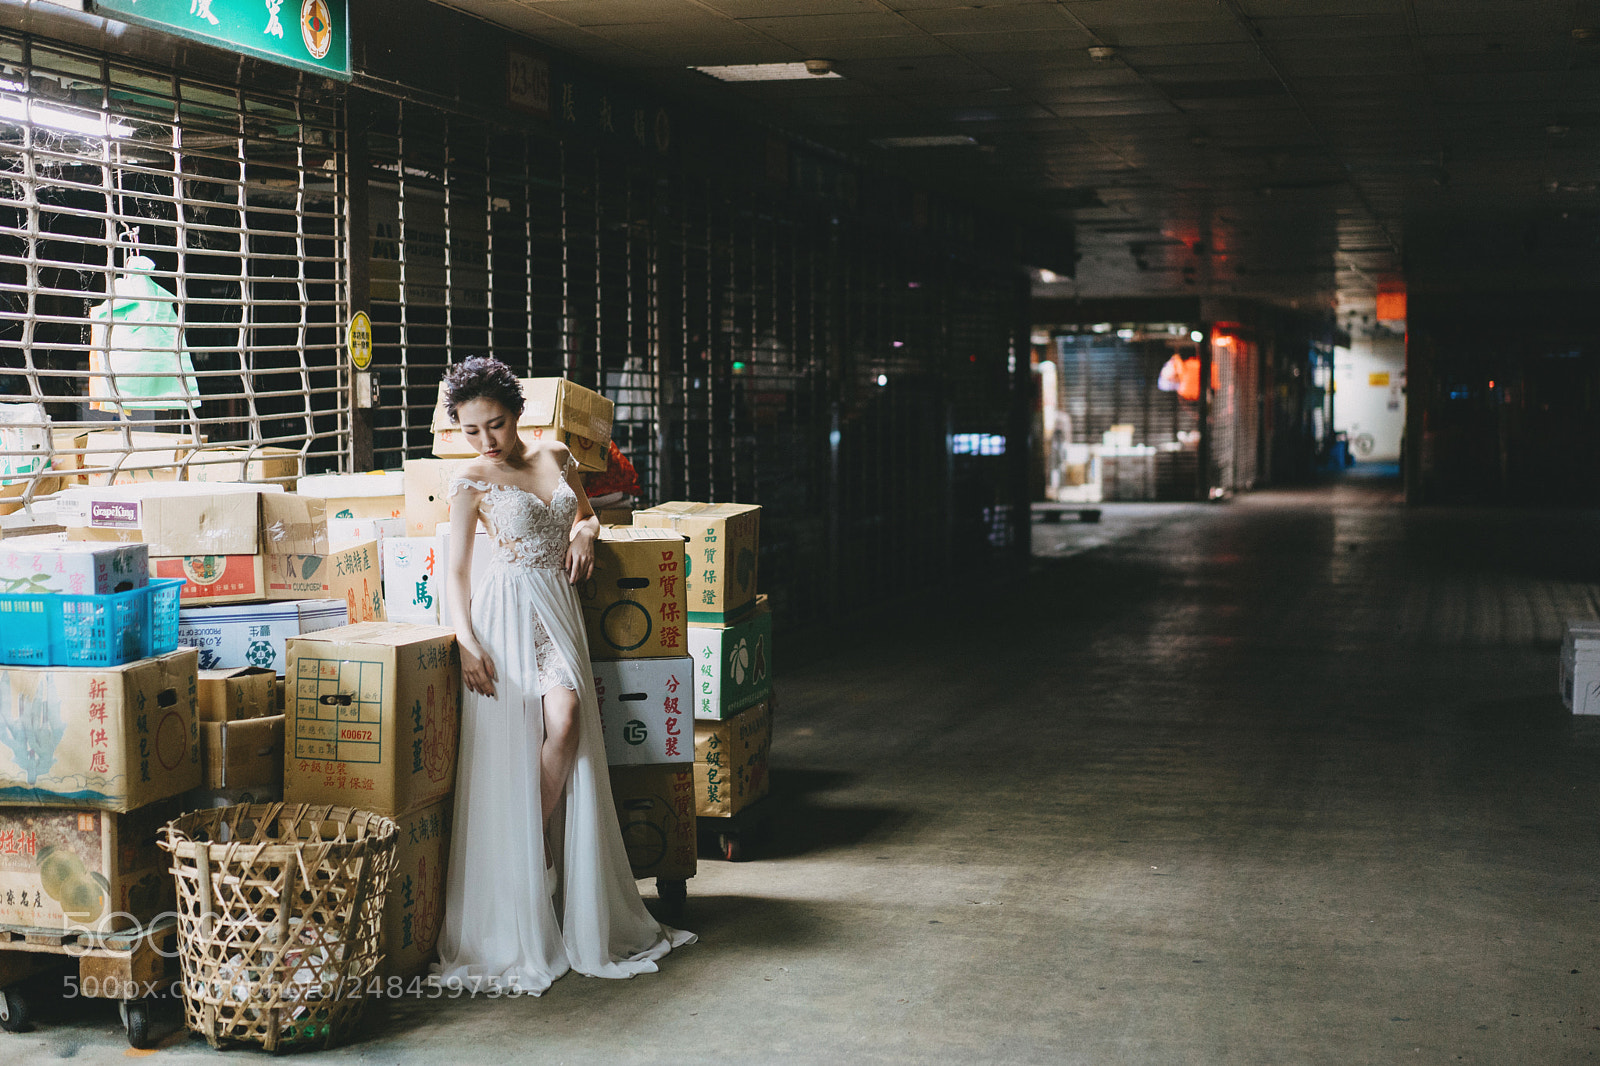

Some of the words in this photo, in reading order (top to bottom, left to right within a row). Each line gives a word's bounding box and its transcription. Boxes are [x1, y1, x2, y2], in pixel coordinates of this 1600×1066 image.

[336, 547, 371, 577] 大湖特產
[702, 527, 717, 605] 品質保證
[658, 551, 682, 648] 品質保證
[701, 645, 714, 713] 分級包裝
[88, 678, 109, 773] 新鮮供應
[341, 728, 372, 740] K00672
[663, 674, 682, 757] 分級包裝
[323, 777, 374, 791] 品質保證
[705, 732, 721, 803] 分級包裝
